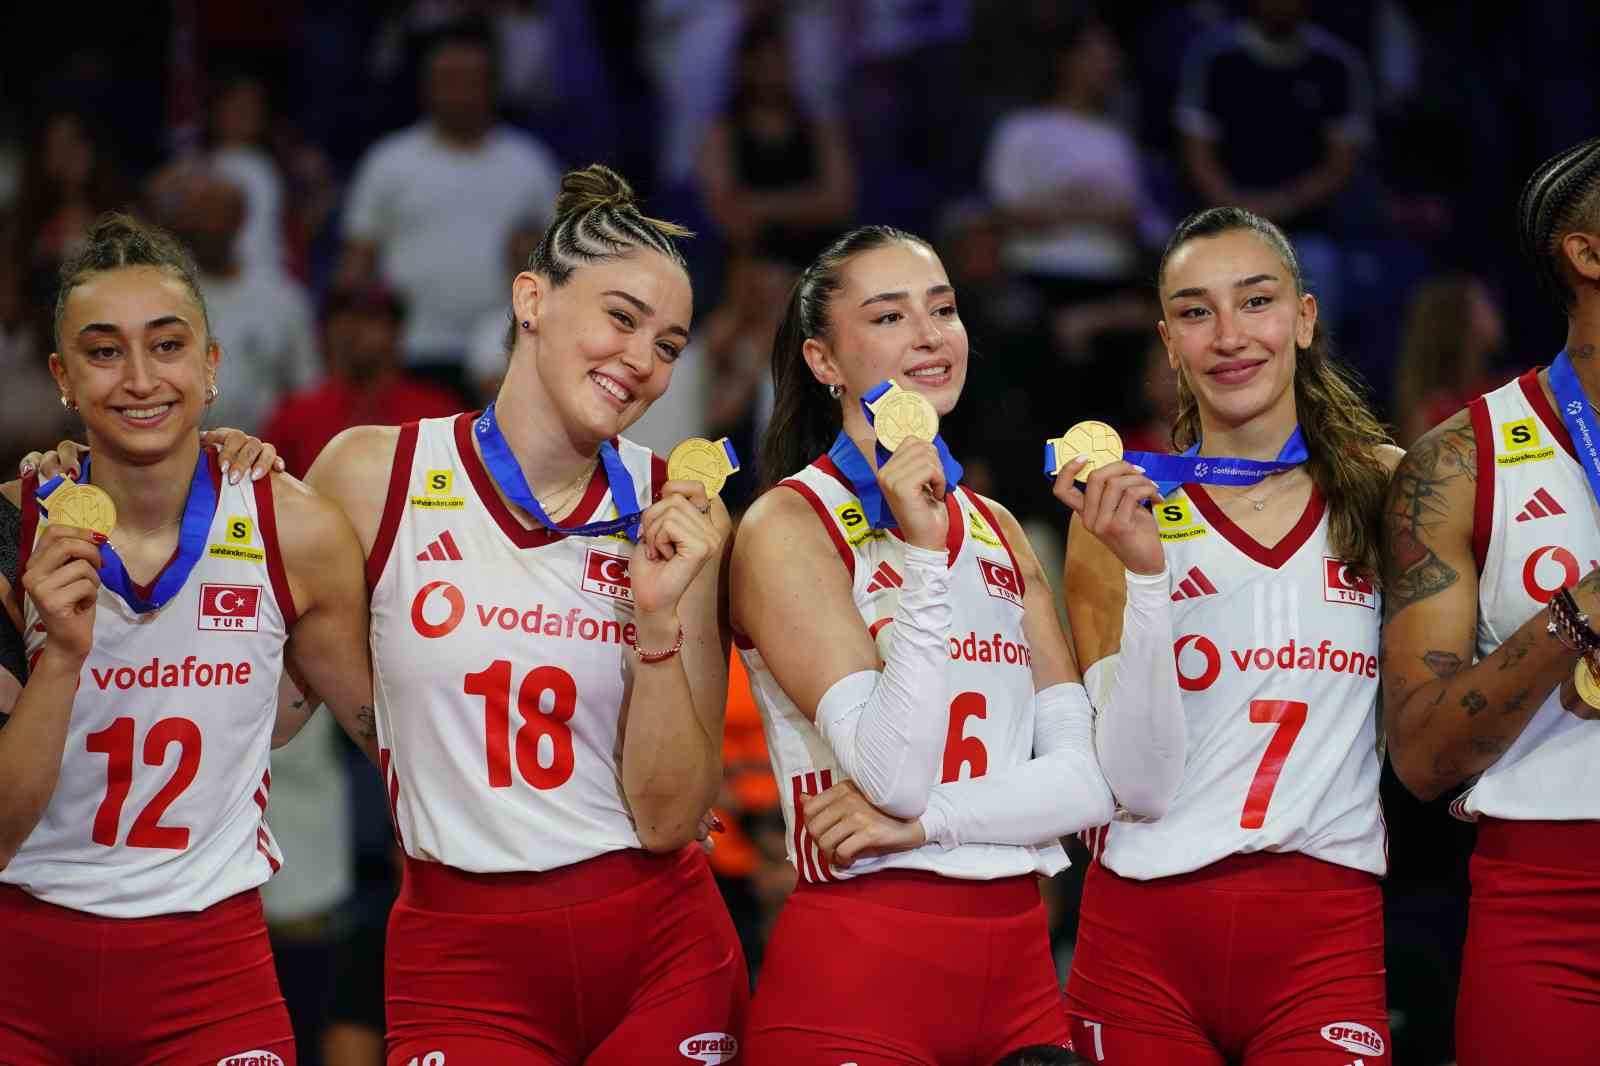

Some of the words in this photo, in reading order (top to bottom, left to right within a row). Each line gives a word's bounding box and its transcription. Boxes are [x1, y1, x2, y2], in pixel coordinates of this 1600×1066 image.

[1511, 425, 1531, 443] S
[432, 474, 447, 490] S
[841, 508, 862, 527] S
[1163, 505, 1183, 522] S
[232, 522, 246, 538] S
[598, 582, 629, 598] TUR
[1338, 590, 1366, 604] TUR
[212, 618, 244, 628] TUR
[476, 603, 637, 646] vodafone
[948, 631, 1032, 667] odafon
[1230, 639, 1377, 679] vodafone
[91, 655, 252, 690] vodafone
[463, 659, 577, 790] 18
[941, 691, 989, 784] 6
[1240, 700, 1309, 829] 7
[86, 716, 202, 850] 12
[687, 1036, 736, 1056] gratis
[1329, 1027, 1381, 1050] gratis
